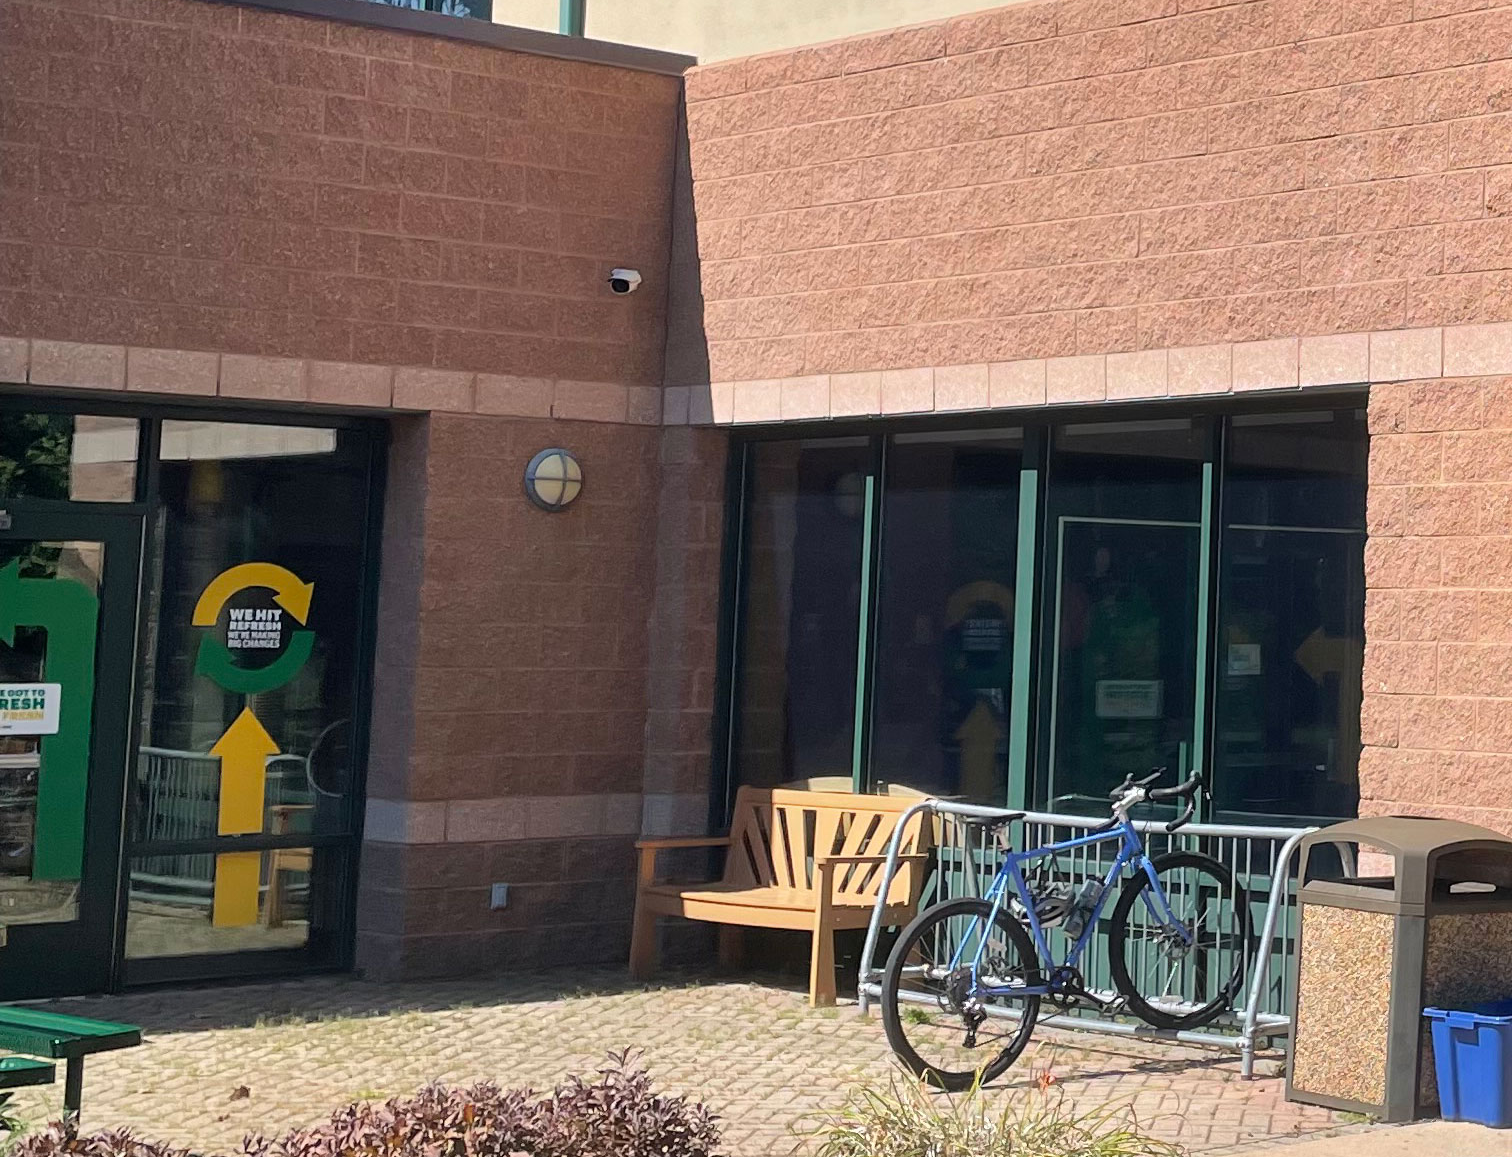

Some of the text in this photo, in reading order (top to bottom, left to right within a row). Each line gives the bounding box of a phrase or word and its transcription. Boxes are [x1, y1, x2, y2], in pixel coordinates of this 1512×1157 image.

[230, 609, 282, 621] WE HIT
[229, 621, 282, 631] REFRESH
